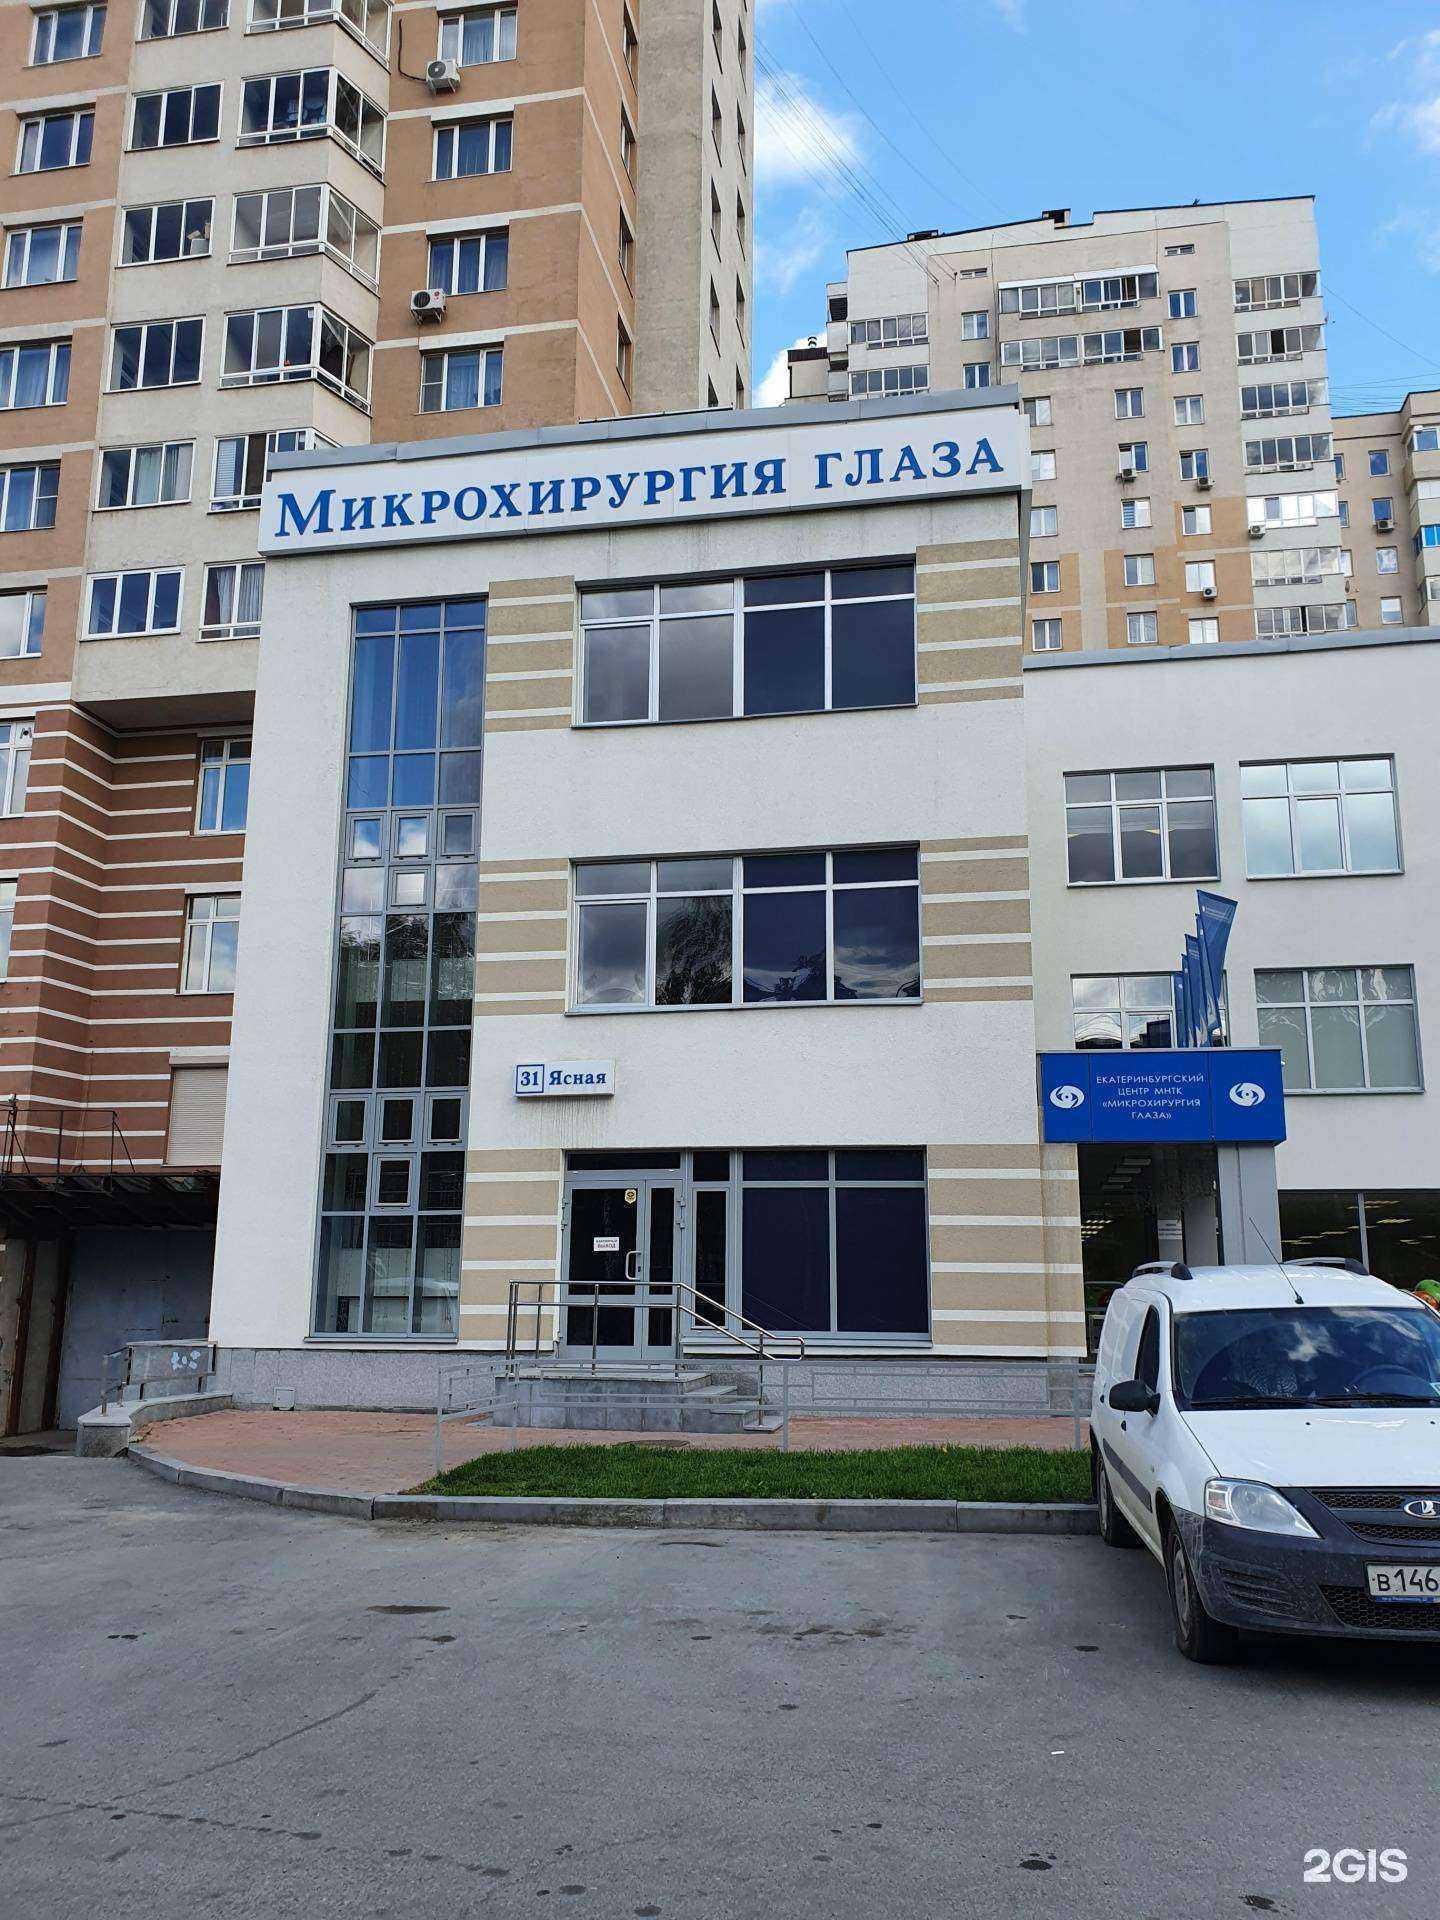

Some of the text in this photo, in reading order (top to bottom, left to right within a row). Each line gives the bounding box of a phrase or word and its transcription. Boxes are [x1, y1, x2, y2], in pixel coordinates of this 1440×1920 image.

[520, 1070, 607, 1087] 31 Ясная
[1096, 1073, 1204, 1084] ЕКАТЕРИНБУРГСКИЙ
[1118, 1087, 1183, 1096] ЦЕНТР МНТК
[1102, 1098, 1201, 1108] «МИКРОХИРУРГИЯ
[1131, 1111, 1172, 1119] ГЛАЗА»
